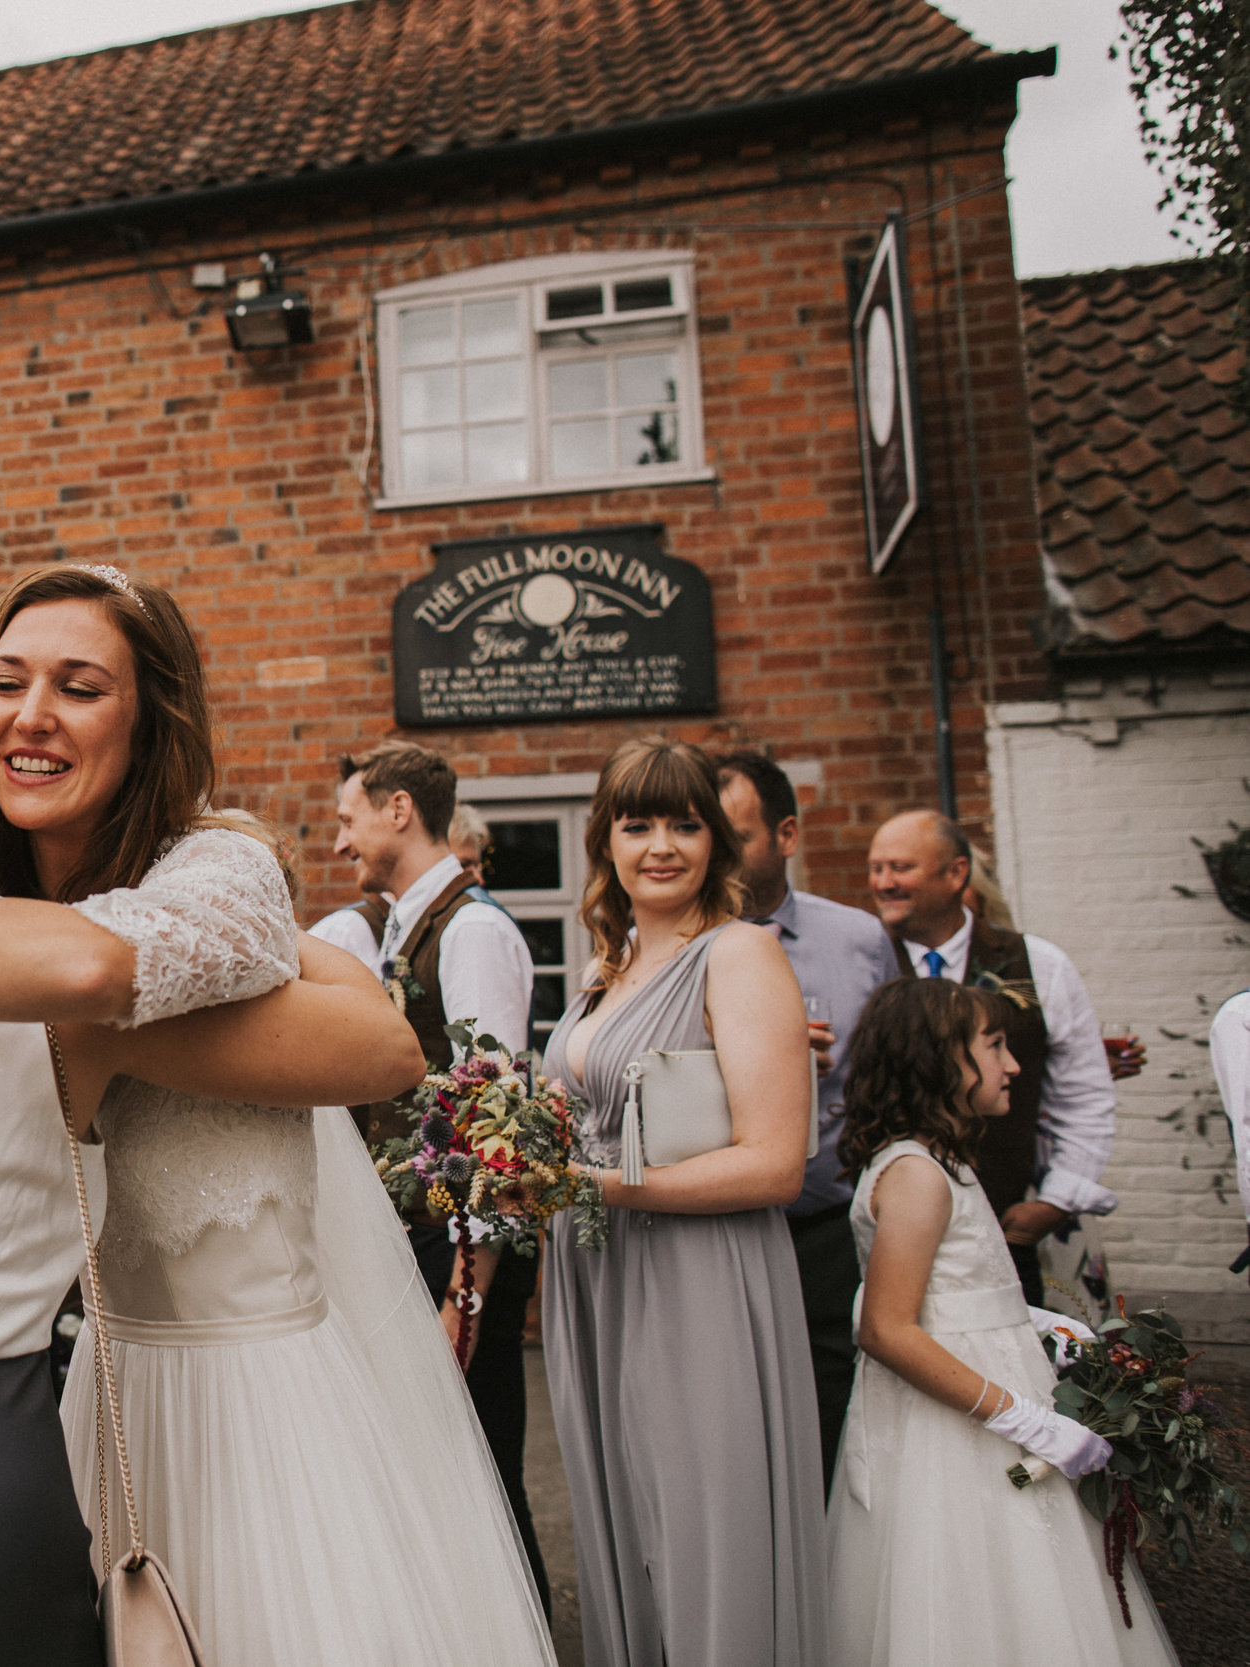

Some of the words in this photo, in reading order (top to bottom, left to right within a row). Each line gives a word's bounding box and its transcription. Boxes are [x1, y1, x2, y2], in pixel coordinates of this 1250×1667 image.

[413, 582, 464, 627] THE
[457, 551, 525, 596] FULL
[524, 544, 624, 580] MOON
[622, 558, 681, 610] INN
[539, 620, 629, 661] House
